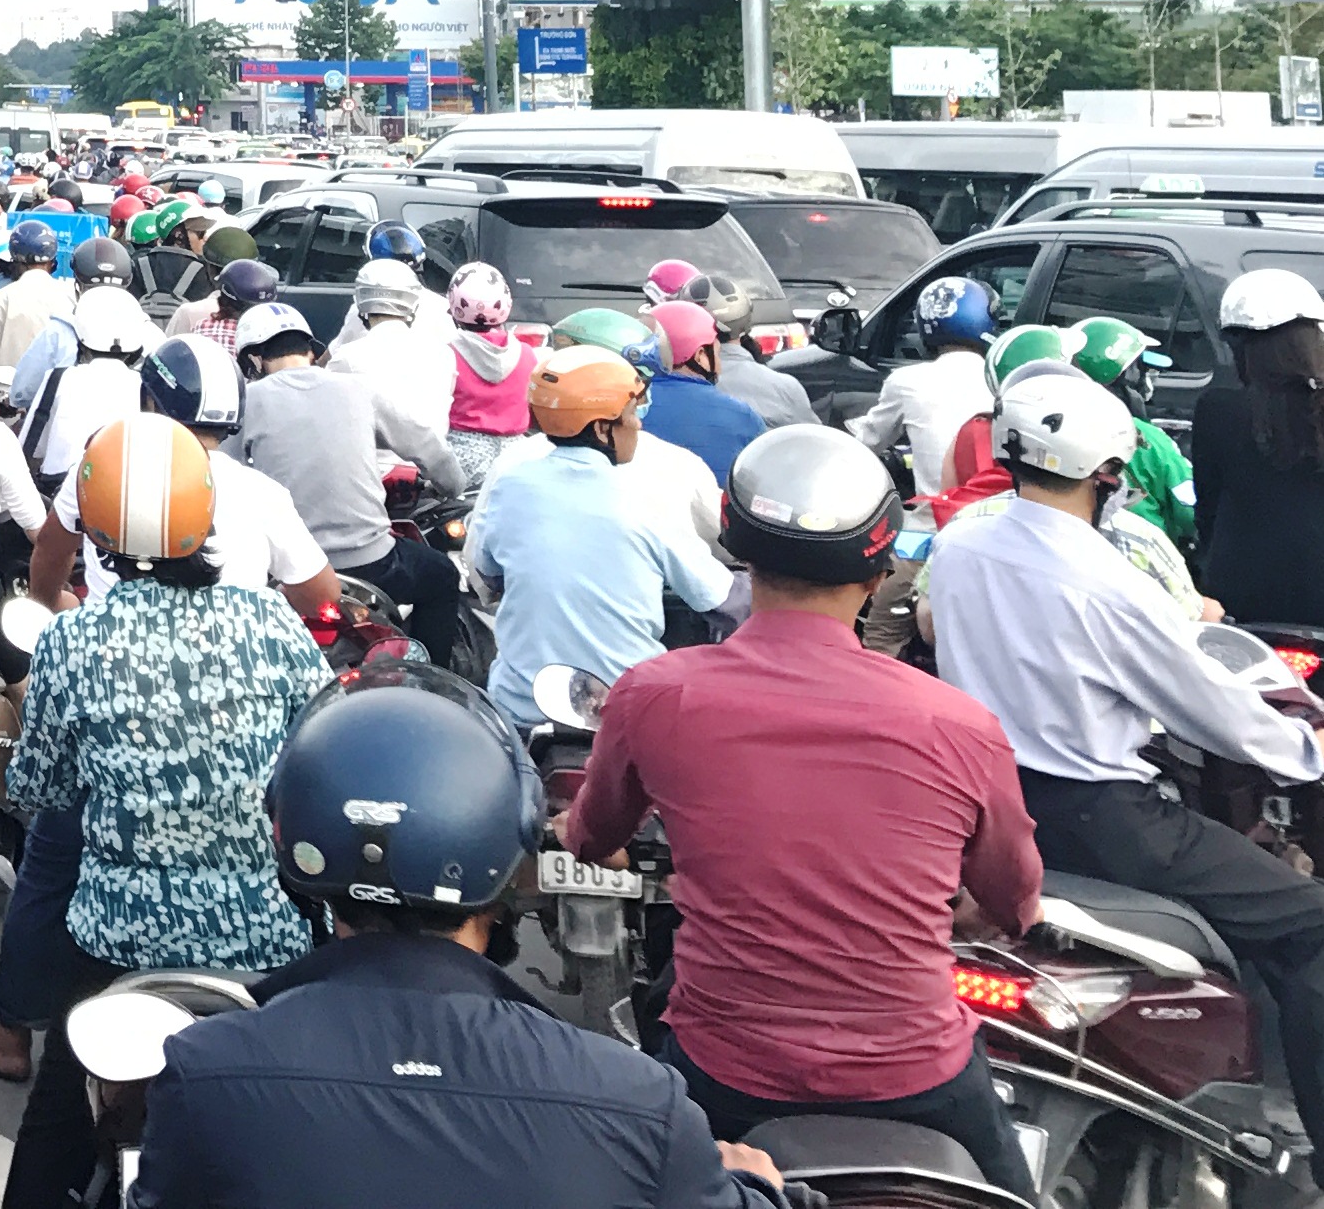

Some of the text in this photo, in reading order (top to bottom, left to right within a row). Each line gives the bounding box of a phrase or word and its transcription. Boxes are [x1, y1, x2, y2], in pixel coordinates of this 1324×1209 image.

[159, 212, 177, 229] Grab
[343, 800, 408, 825] GRS
[349, 883, 396, 904] GRS
[392, 1060, 442, 1077] adidas
